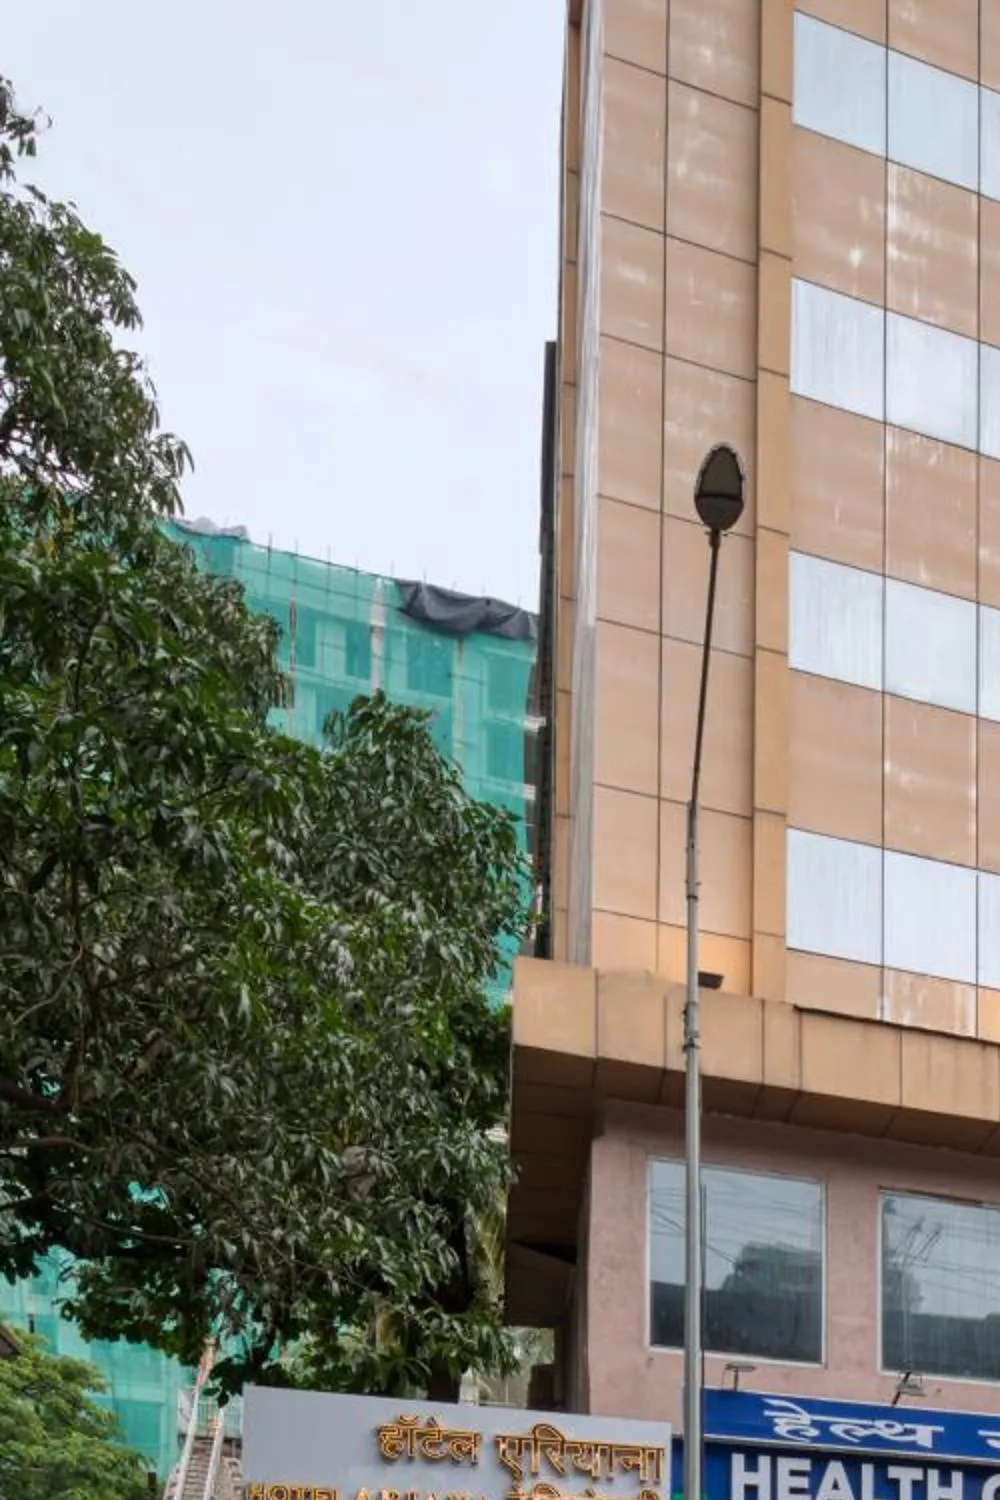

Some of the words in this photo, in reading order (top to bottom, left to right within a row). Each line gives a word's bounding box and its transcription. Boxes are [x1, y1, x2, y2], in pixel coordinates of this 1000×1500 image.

[375, 1414, 483, 1465] हॉटेल
[495, 1422, 667, 1485] एरियाना
[763, 1398, 945, 1448] हेल्थ
